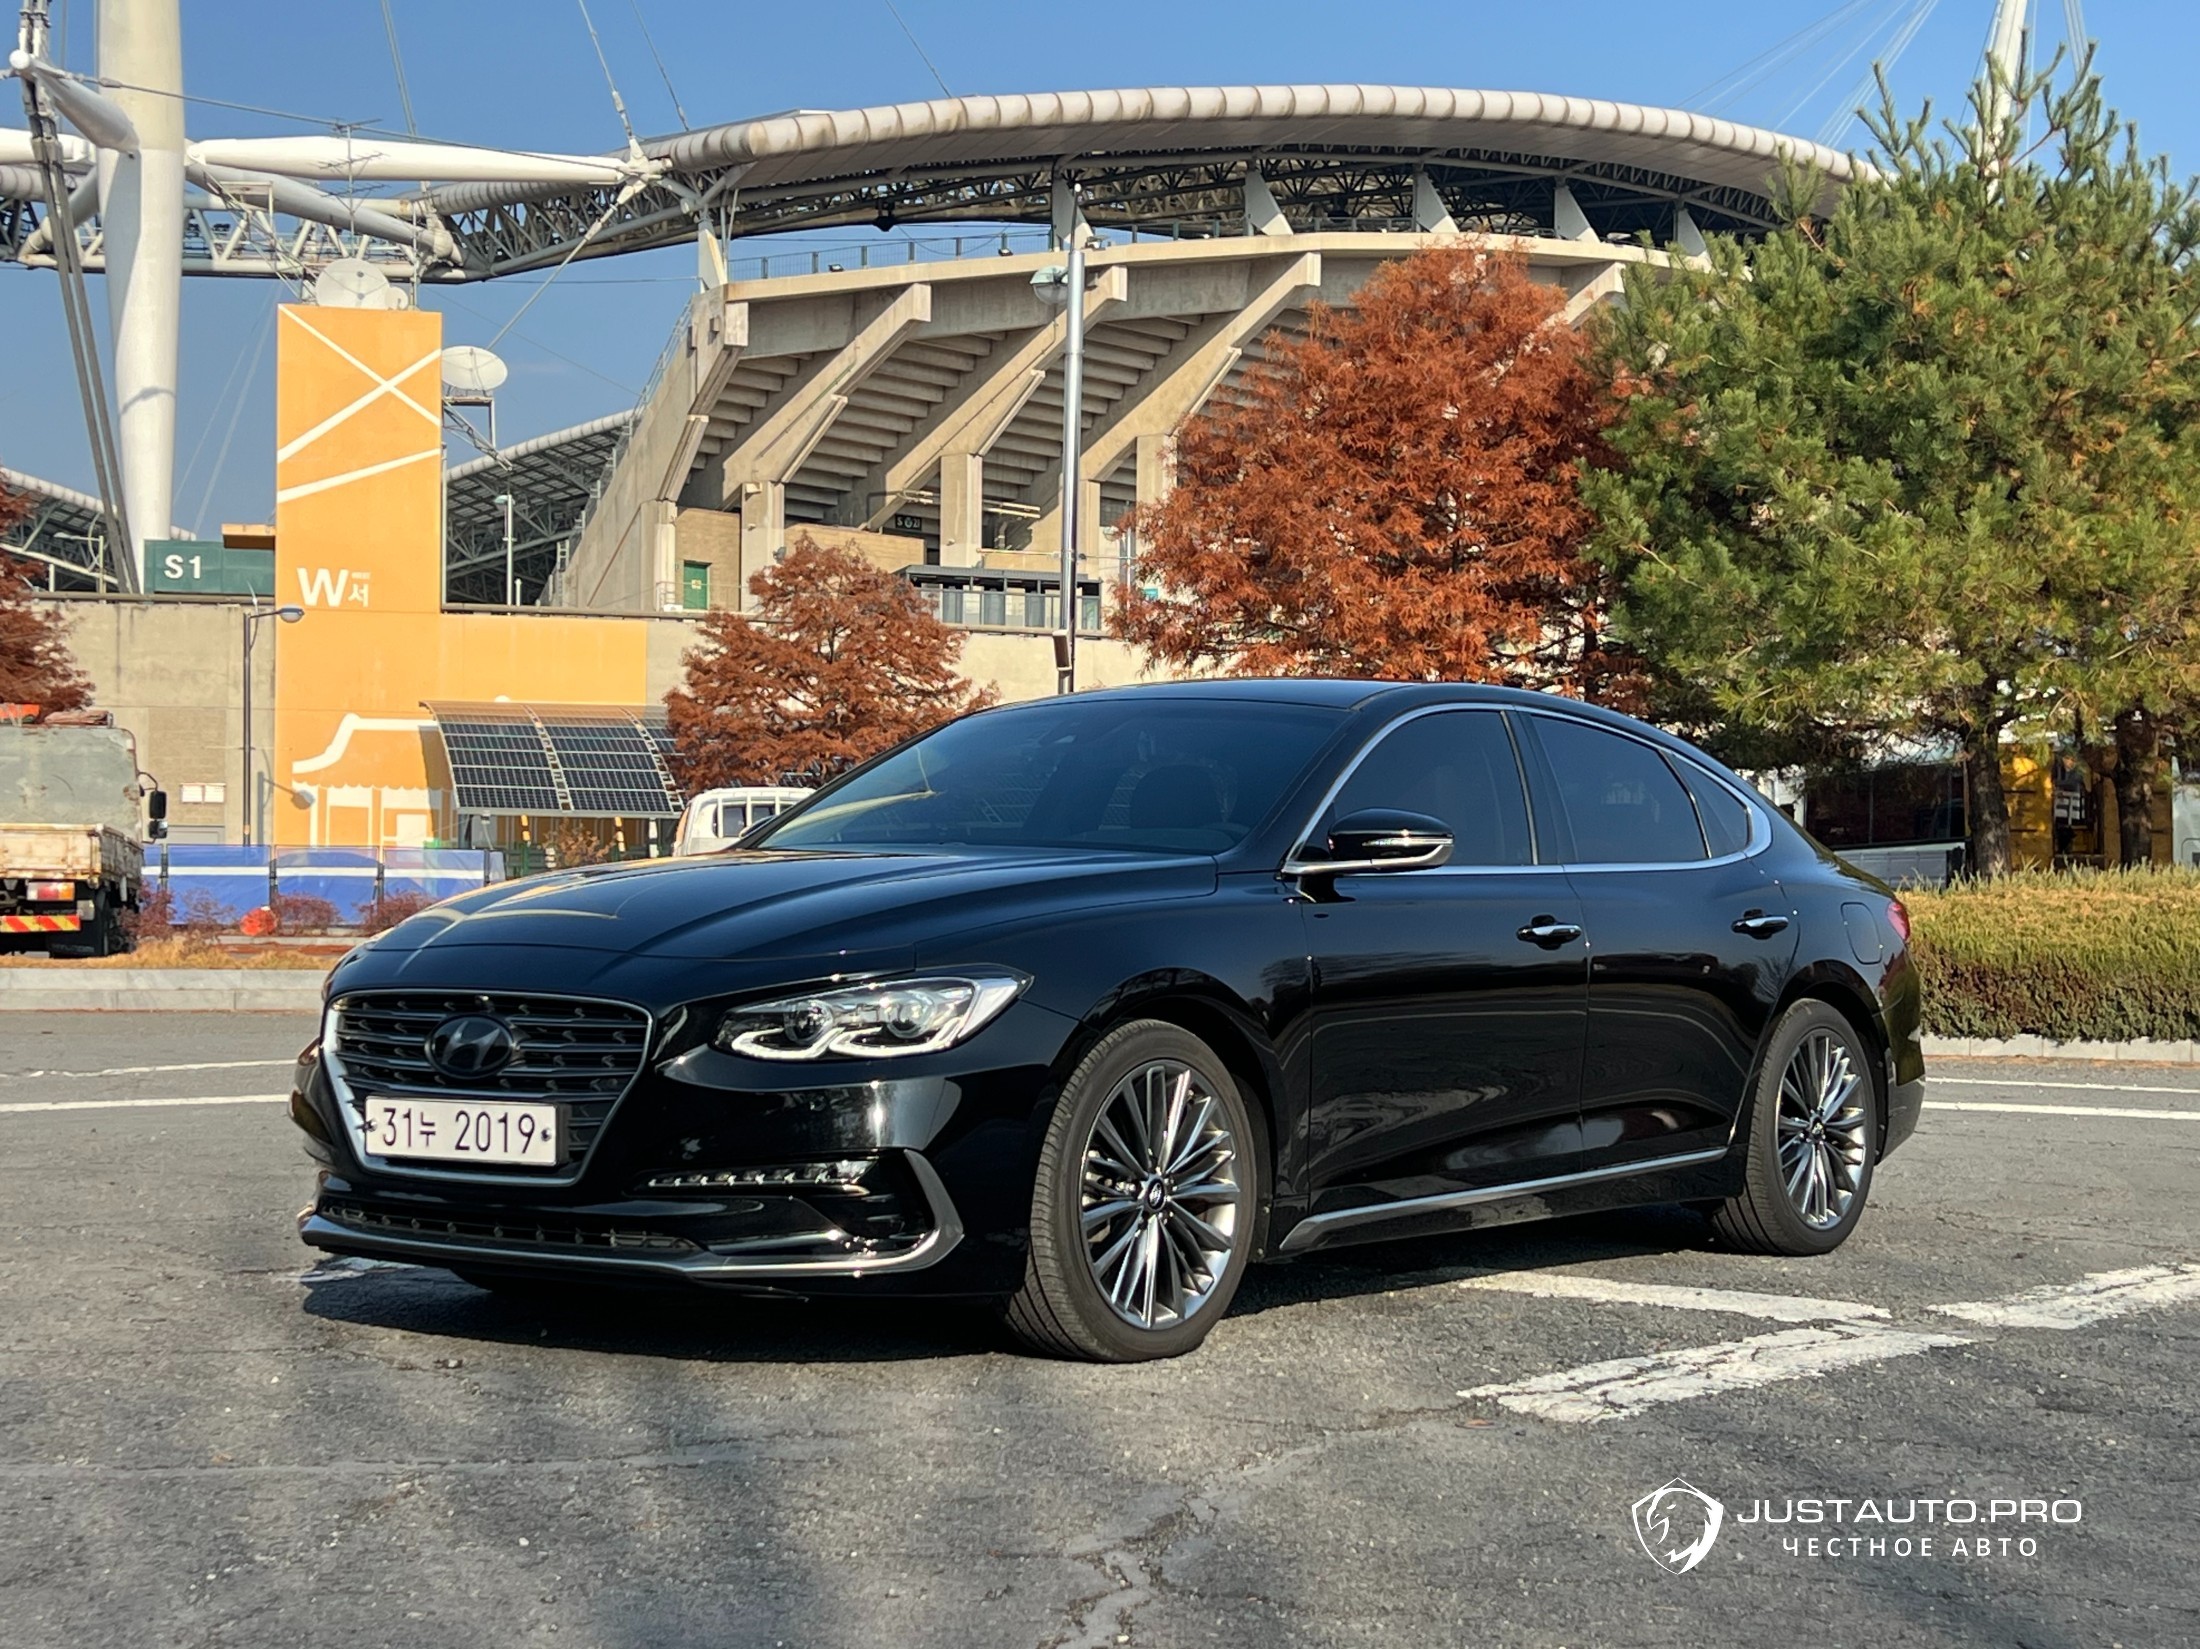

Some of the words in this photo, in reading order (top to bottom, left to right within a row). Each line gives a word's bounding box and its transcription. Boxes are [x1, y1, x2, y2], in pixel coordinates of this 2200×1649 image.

[164, 554, 202, 580] S1
[296, 567, 349, 607] W
[347, 583, 369, 608] 서
[382, 1107, 436, 1148] 31누
[454, 1110, 536, 1154] 2019
